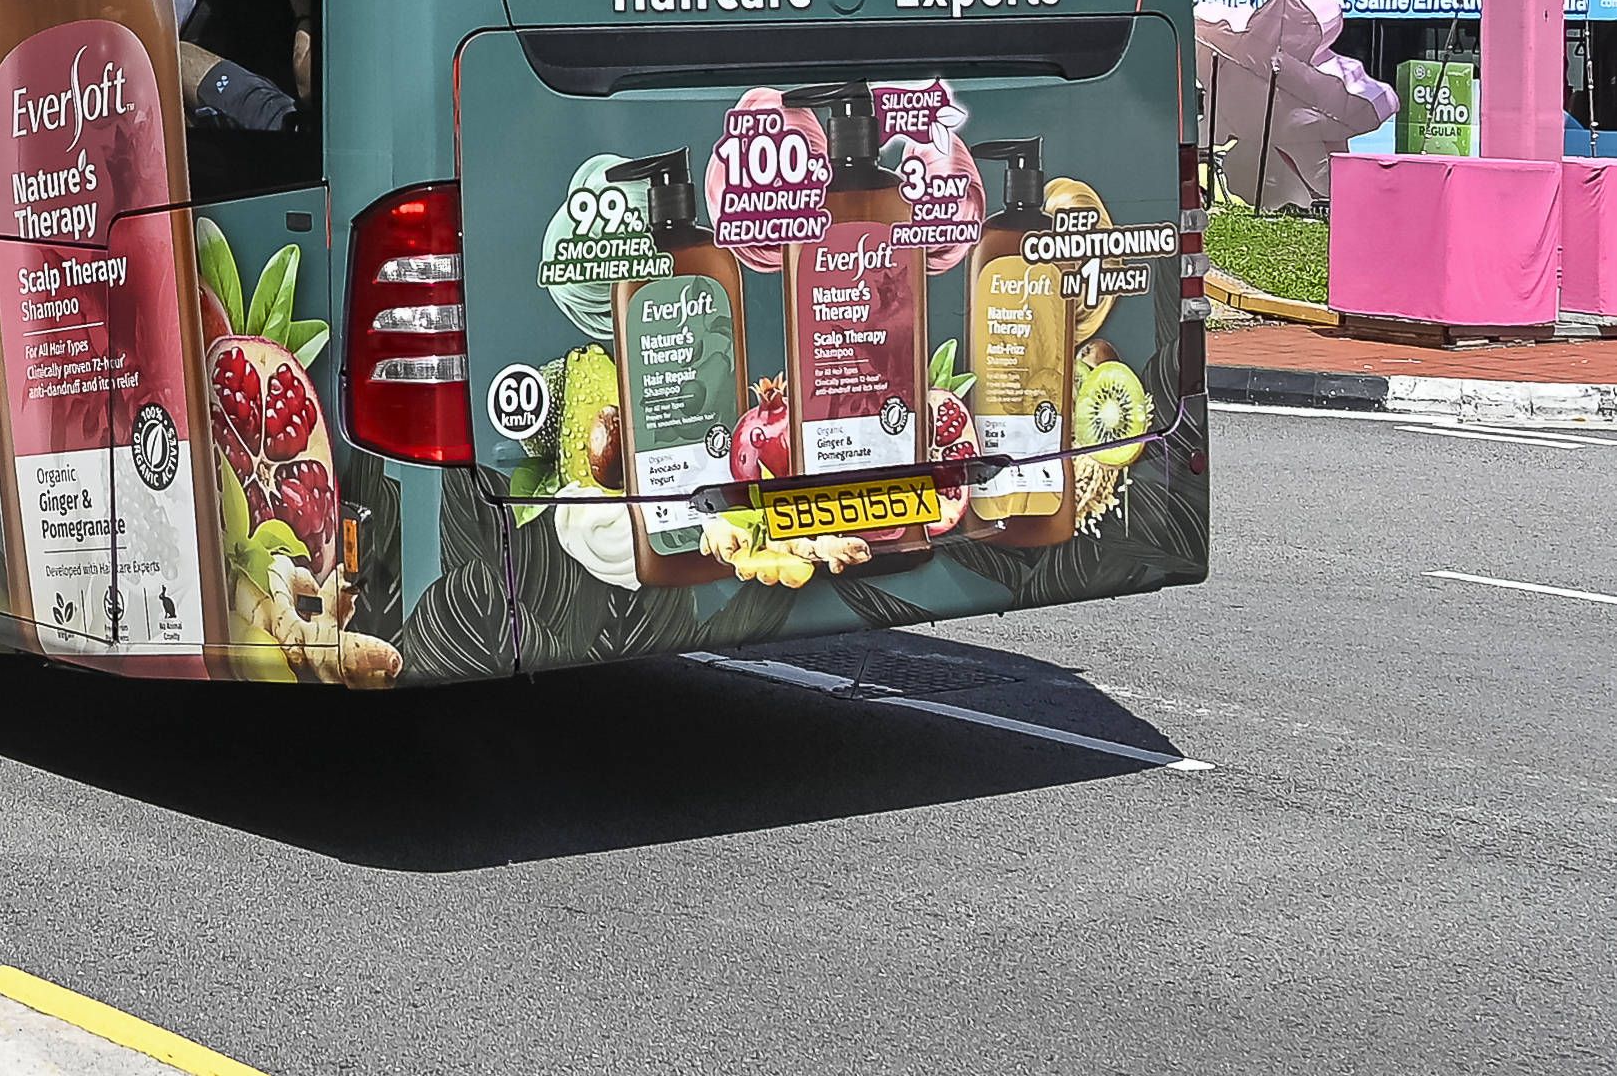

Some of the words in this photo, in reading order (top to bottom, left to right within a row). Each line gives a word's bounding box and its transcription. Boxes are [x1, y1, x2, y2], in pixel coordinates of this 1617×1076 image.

[881, 91, 942, 109] SILICONE
[729, 115, 754, 134] UP
[756, 113, 782, 133] TO
[885, 110, 929, 133] FREE
[718, 134, 829, 186] 100%
[11, 149, 97, 204] Nature's
[902, 159, 968, 200] 3-DAY
[724, 189, 821, 212] DANDRUFF
[914, 202, 958, 221] SCALP
[14, 201, 97, 241] Therapy
[569, 190, 644, 236] 99%
[1055, 210, 1098, 232] DEEP
[892, 224, 979, 245] PROTECTION
[1024, 228, 1175, 261] CONDITIONING
[557, 238, 653, 261] SMOOTHER,
[18, 263, 60, 296] Scalp
[62, 256, 127, 287] Therapy
[541, 260, 629, 283] HEALTHIER
[633, 257, 671, 277] HAIR
[812, 280, 871, 304] Nature's
[1063, 274, 1081, 295] IN
[1081, 257, 1101, 306] 1
[1100, 269, 1147, 292] WASH
[21, 298, 79, 322] Shampoo
[812, 304, 870, 323] Therapy
[640, 325, 694, 350] Nature's
[813, 331, 843, 348] Scalp
[844, 329, 887, 345] Therapy
[987, 320, 1031, 338] Therapy
[25, 345, 36, 359] For
[38, 342, 49, 357] All
[49, 340, 65, 356] Hair
[67, 339, 88, 357] Types
[640, 347, 694, 365] Therapy
[814, 348, 854, 360] Shampoo
[27, 363, 62, 380] Clinically
[64, 361, 91, 378] proven
[643, 372, 664, 387] Hair
[664, 367, 696, 385] Repair
[29, 378, 80, 399] anti-dandruff
[82, 375, 98, 393] and
[116, 371, 139, 388] relief
[498, 376, 539, 413] 60
[643, 385, 681, 399] Shampoo
[141, 406, 163, 422] 100%
[501, 411, 536, 427] km/h
[817, 438, 844, 450] Ginger
[846, 436, 853, 446] &
[133, 432, 160, 486] ORGANIC
[817, 448, 872, 462] Pomegranate
[37, 464, 76, 487] Organic
[649, 463, 681, 475] Avocado
[649, 475, 675, 487] Yogurt
[39, 490, 78, 516] Ginger
[82, 489, 92, 509] &
[46, 564, 81, 578] Developed
[83, 562, 98, 575] with
[99, 561, 130, 575] Haare
[132, 561, 160, 575] Experts
